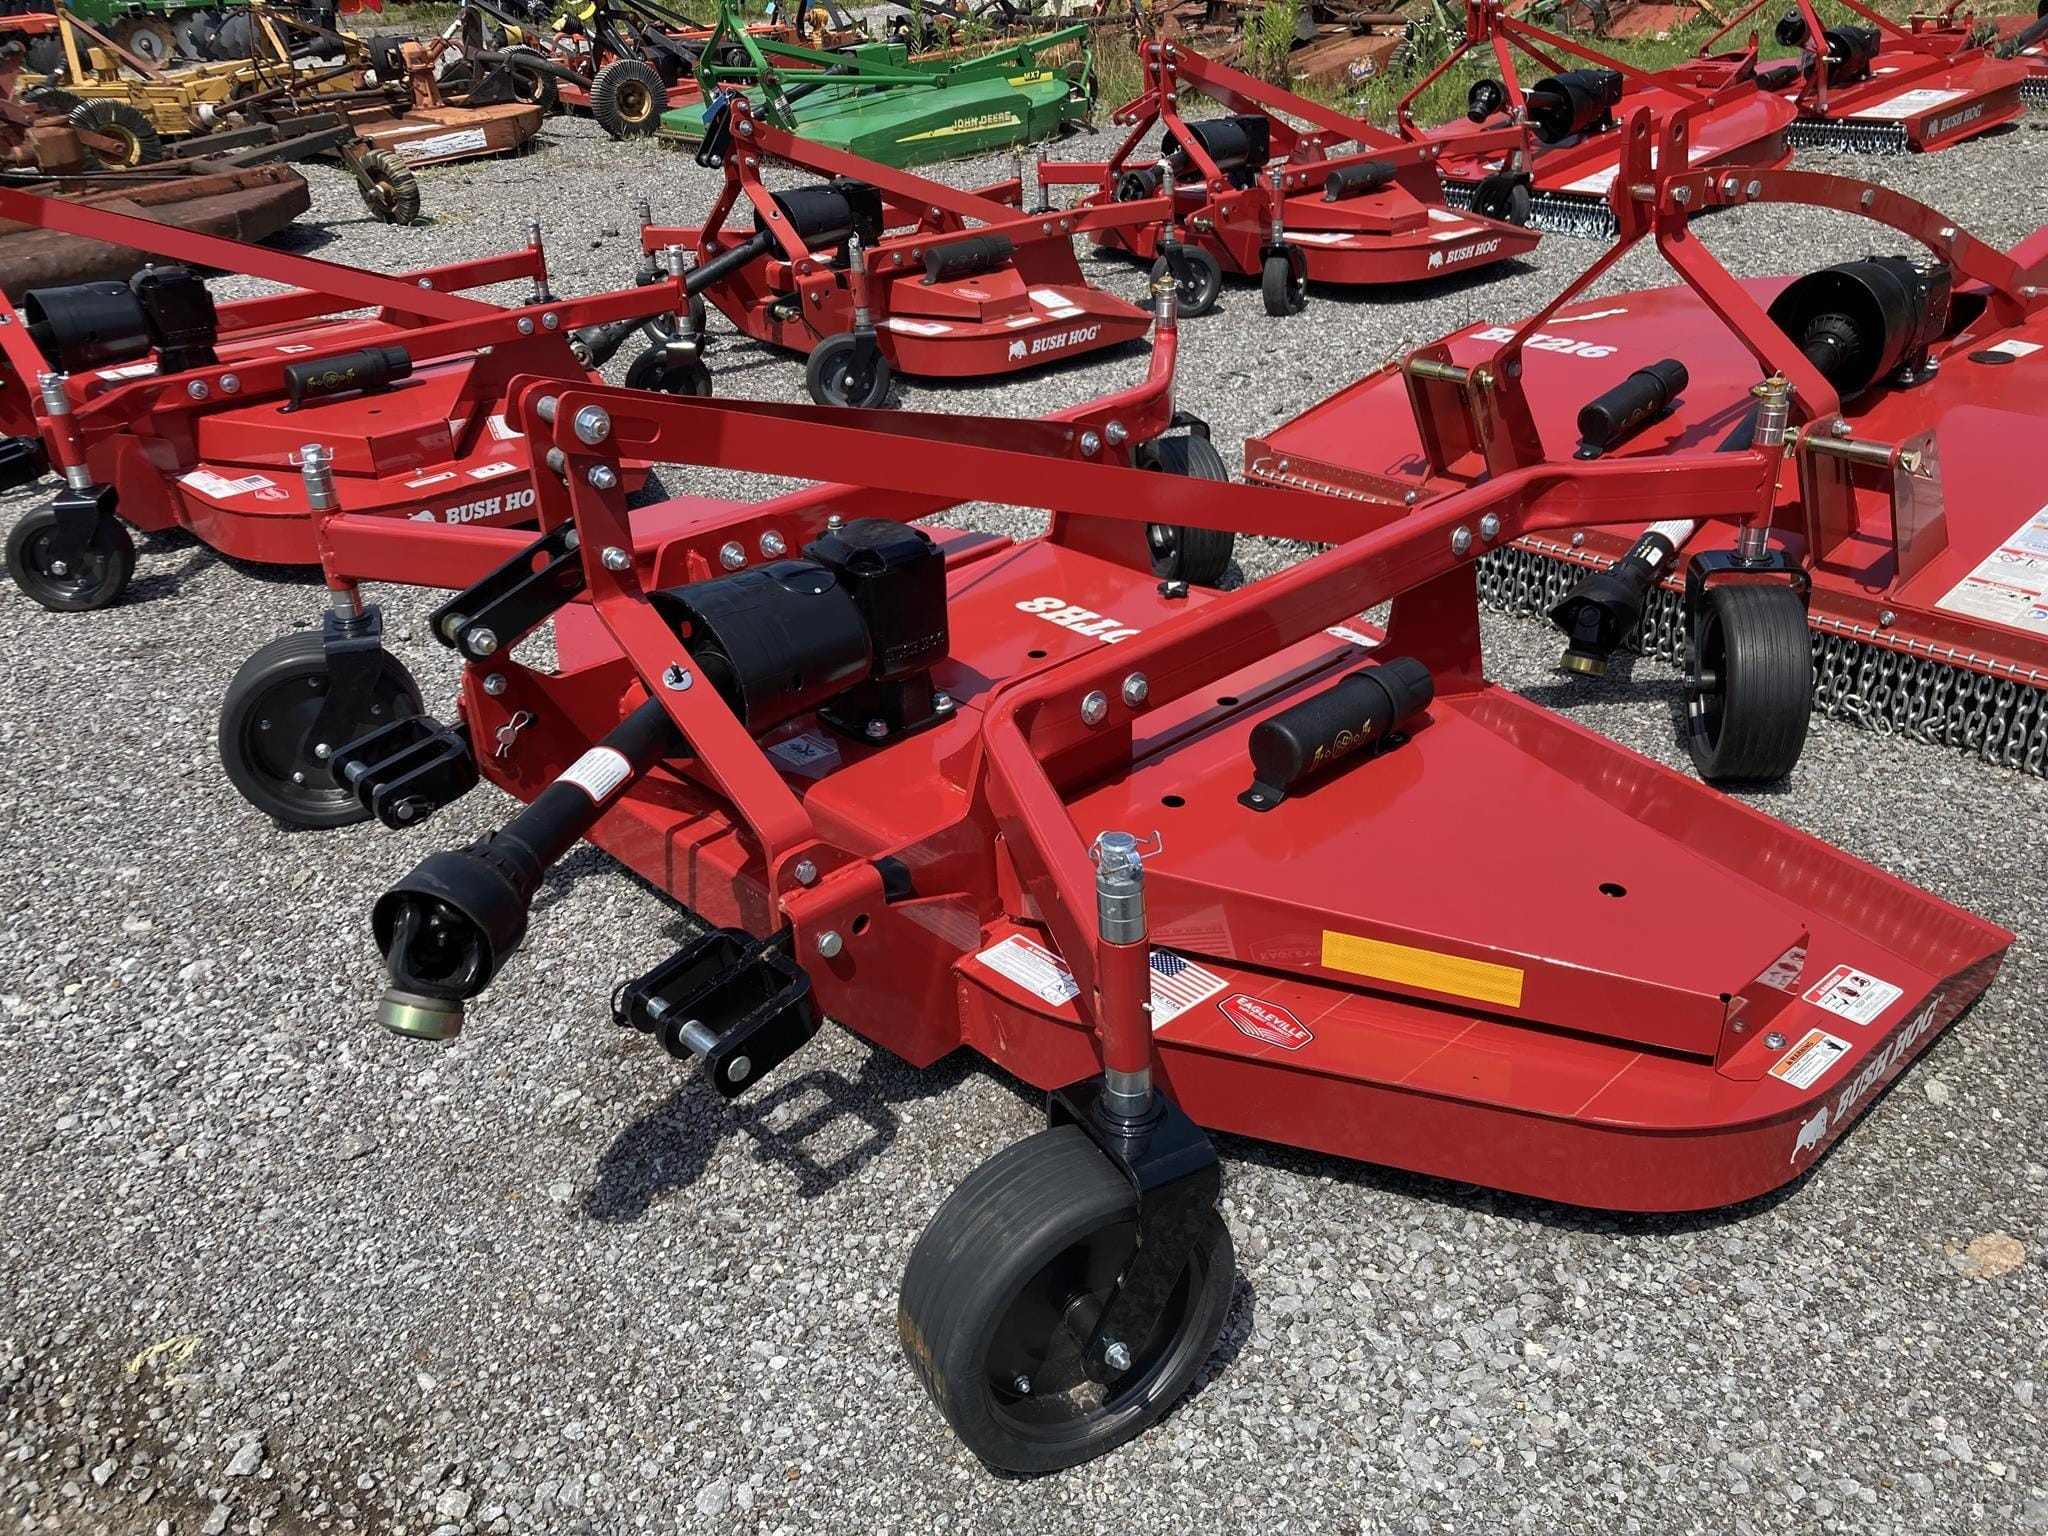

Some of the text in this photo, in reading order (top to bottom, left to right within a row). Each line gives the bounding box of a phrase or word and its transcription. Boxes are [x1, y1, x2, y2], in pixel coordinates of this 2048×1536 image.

[1023, 70, 1041, 81] MX7
[951, 111, 1012, 131] JOHN DEERE
[1940, 104, 1982, 132] BUSH HOG
[1446, 239, 1498, 264] BUSH HOG
[1031, 326, 1097, 354] BUSH HOG
[445, 488, 536, 525] BUSH HO
[1165, 1000, 1181, 1010] USA
[1236, 997, 1307, 1039] EAGLEVILLE
[1790, 1041, 1815, 1063] WARNING
[1832, 1042, 1894, 1125] BUSH
[1889, 998, 1939, 1066] HOG
